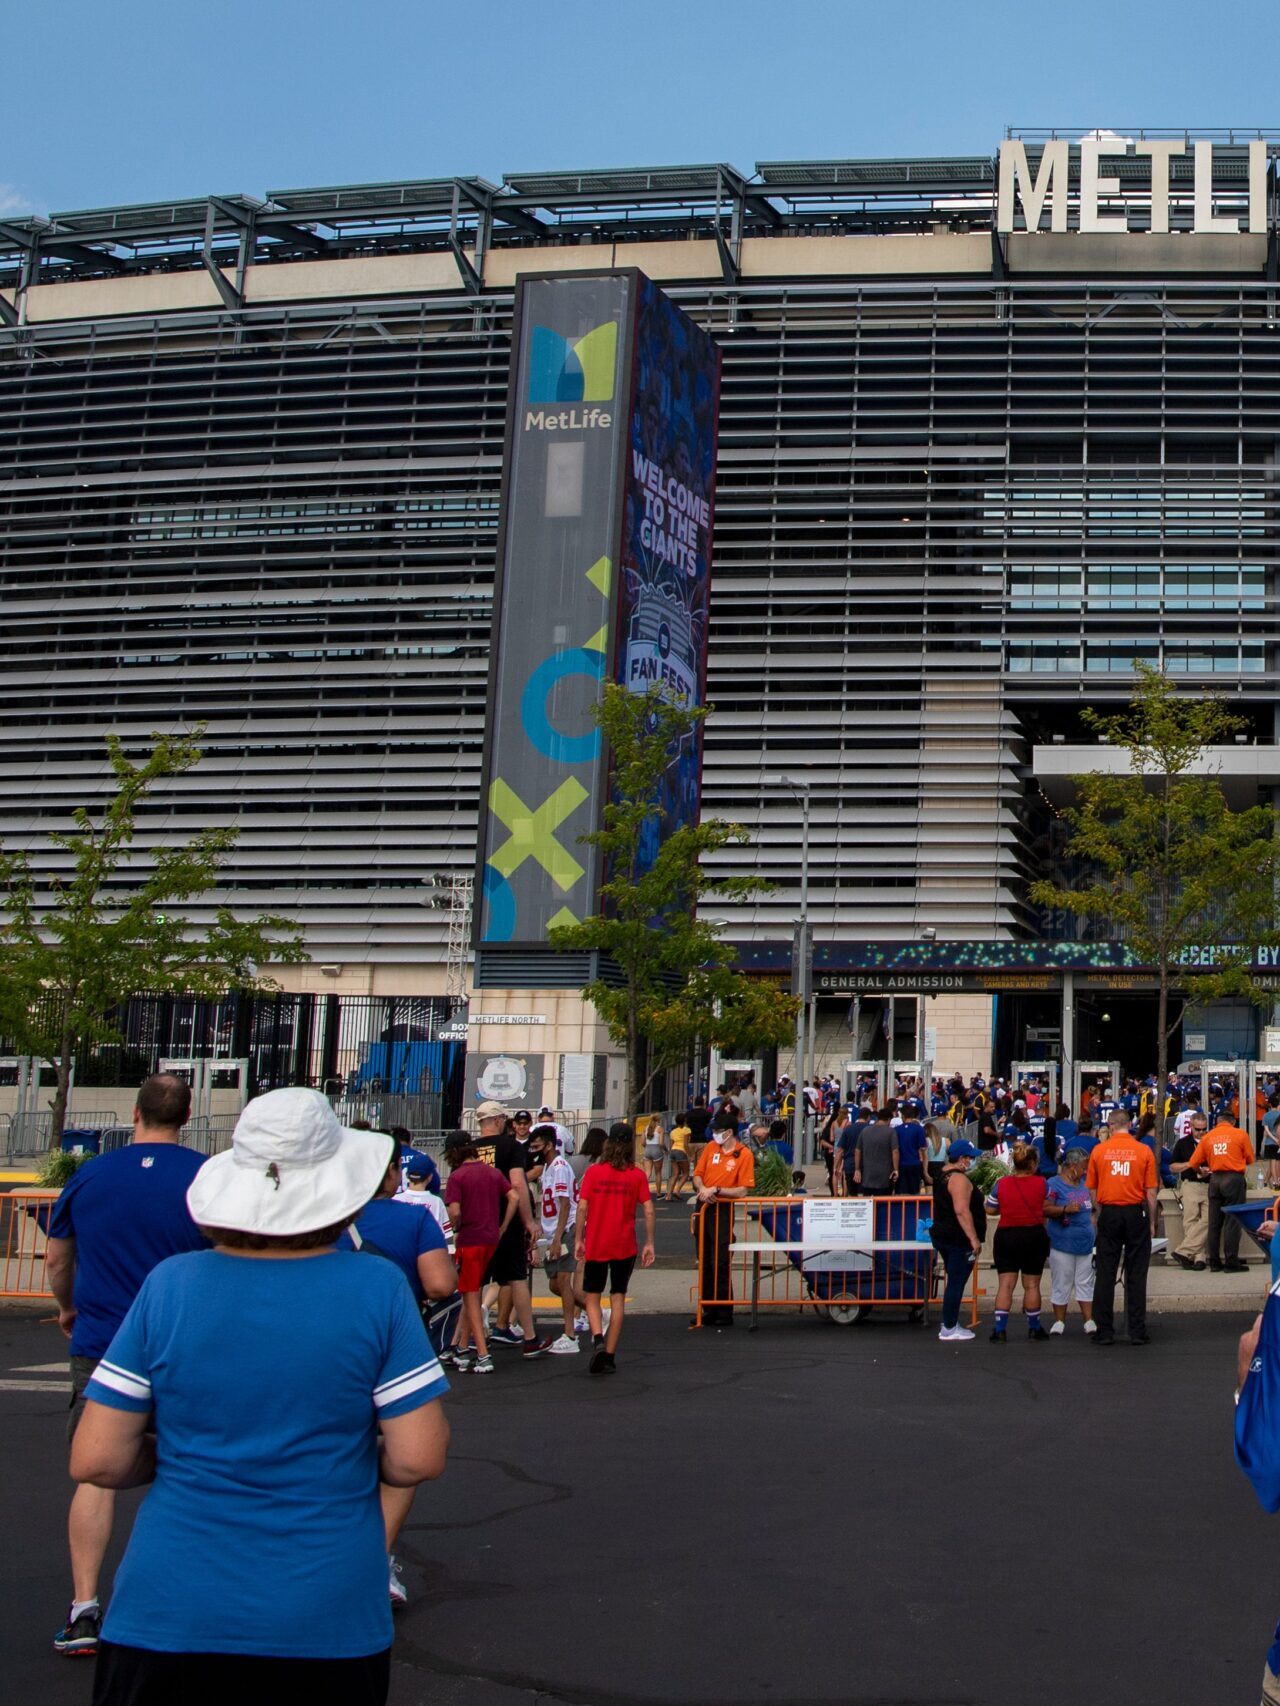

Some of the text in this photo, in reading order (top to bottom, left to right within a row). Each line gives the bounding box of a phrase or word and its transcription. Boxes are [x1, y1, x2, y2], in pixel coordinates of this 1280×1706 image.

[525, 408, 612, 431] MetLife
[633, 449, 709, 528] WELCOME
[643, 488, 698, 549] TO THE
[641, 519, 697, 577] GIANTS
[631, 657, 691, 708] FAN FEST
[1258, 945, 1279, 965] BY
[821, 977, 963, 987] GENERAL ADMISSION
[1213, 1143, 1227, 1155] 622
[1111, 1160, 1130, 1176] 340
